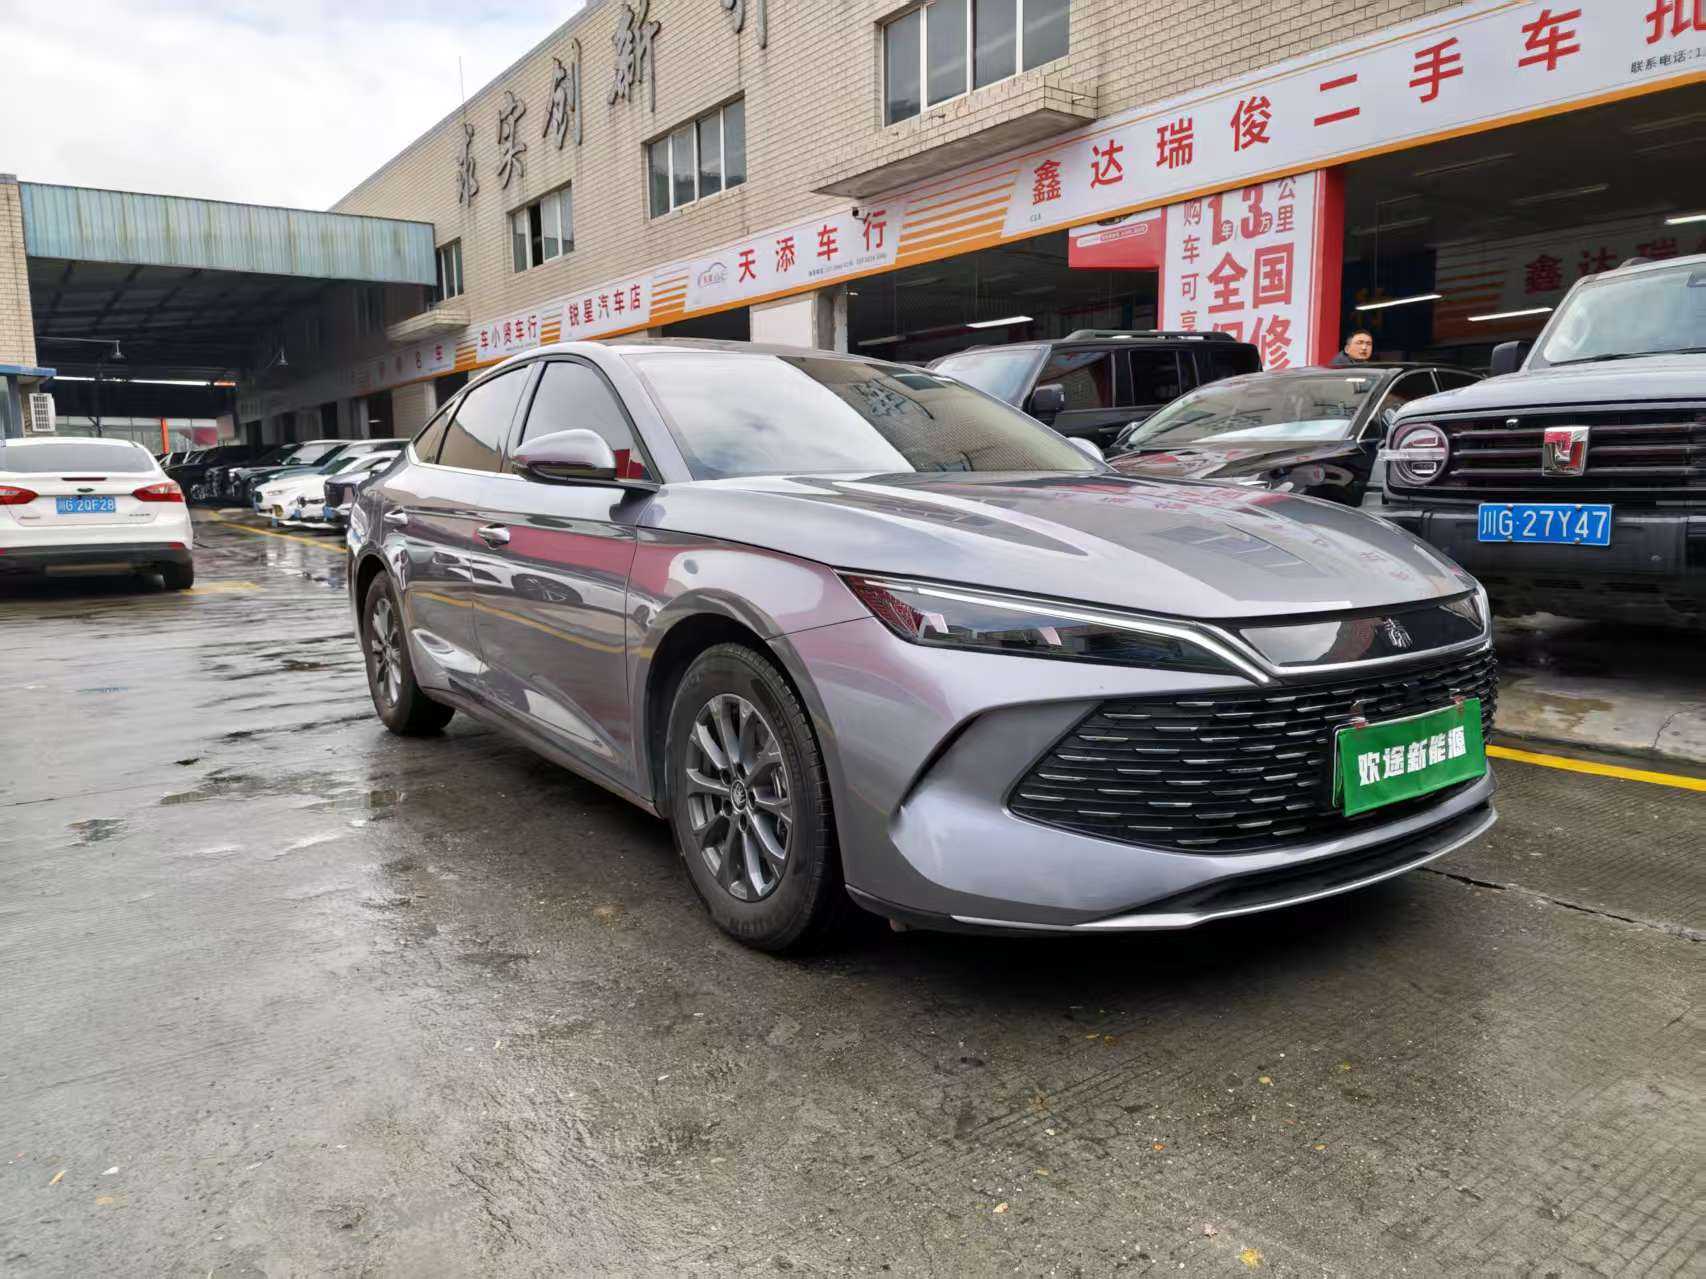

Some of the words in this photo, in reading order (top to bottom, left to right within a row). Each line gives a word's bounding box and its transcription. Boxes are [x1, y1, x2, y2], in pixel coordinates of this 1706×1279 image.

[738, 209, 887, 283] 天添车行
[567, 284, 641, 328] 锐星汽车店
[1207, 242, 1296, 314] 全国
[1482, 509, 1608, 539] 川G·27Y47
[1357, 725, 1467, 787] 欢途新能源
